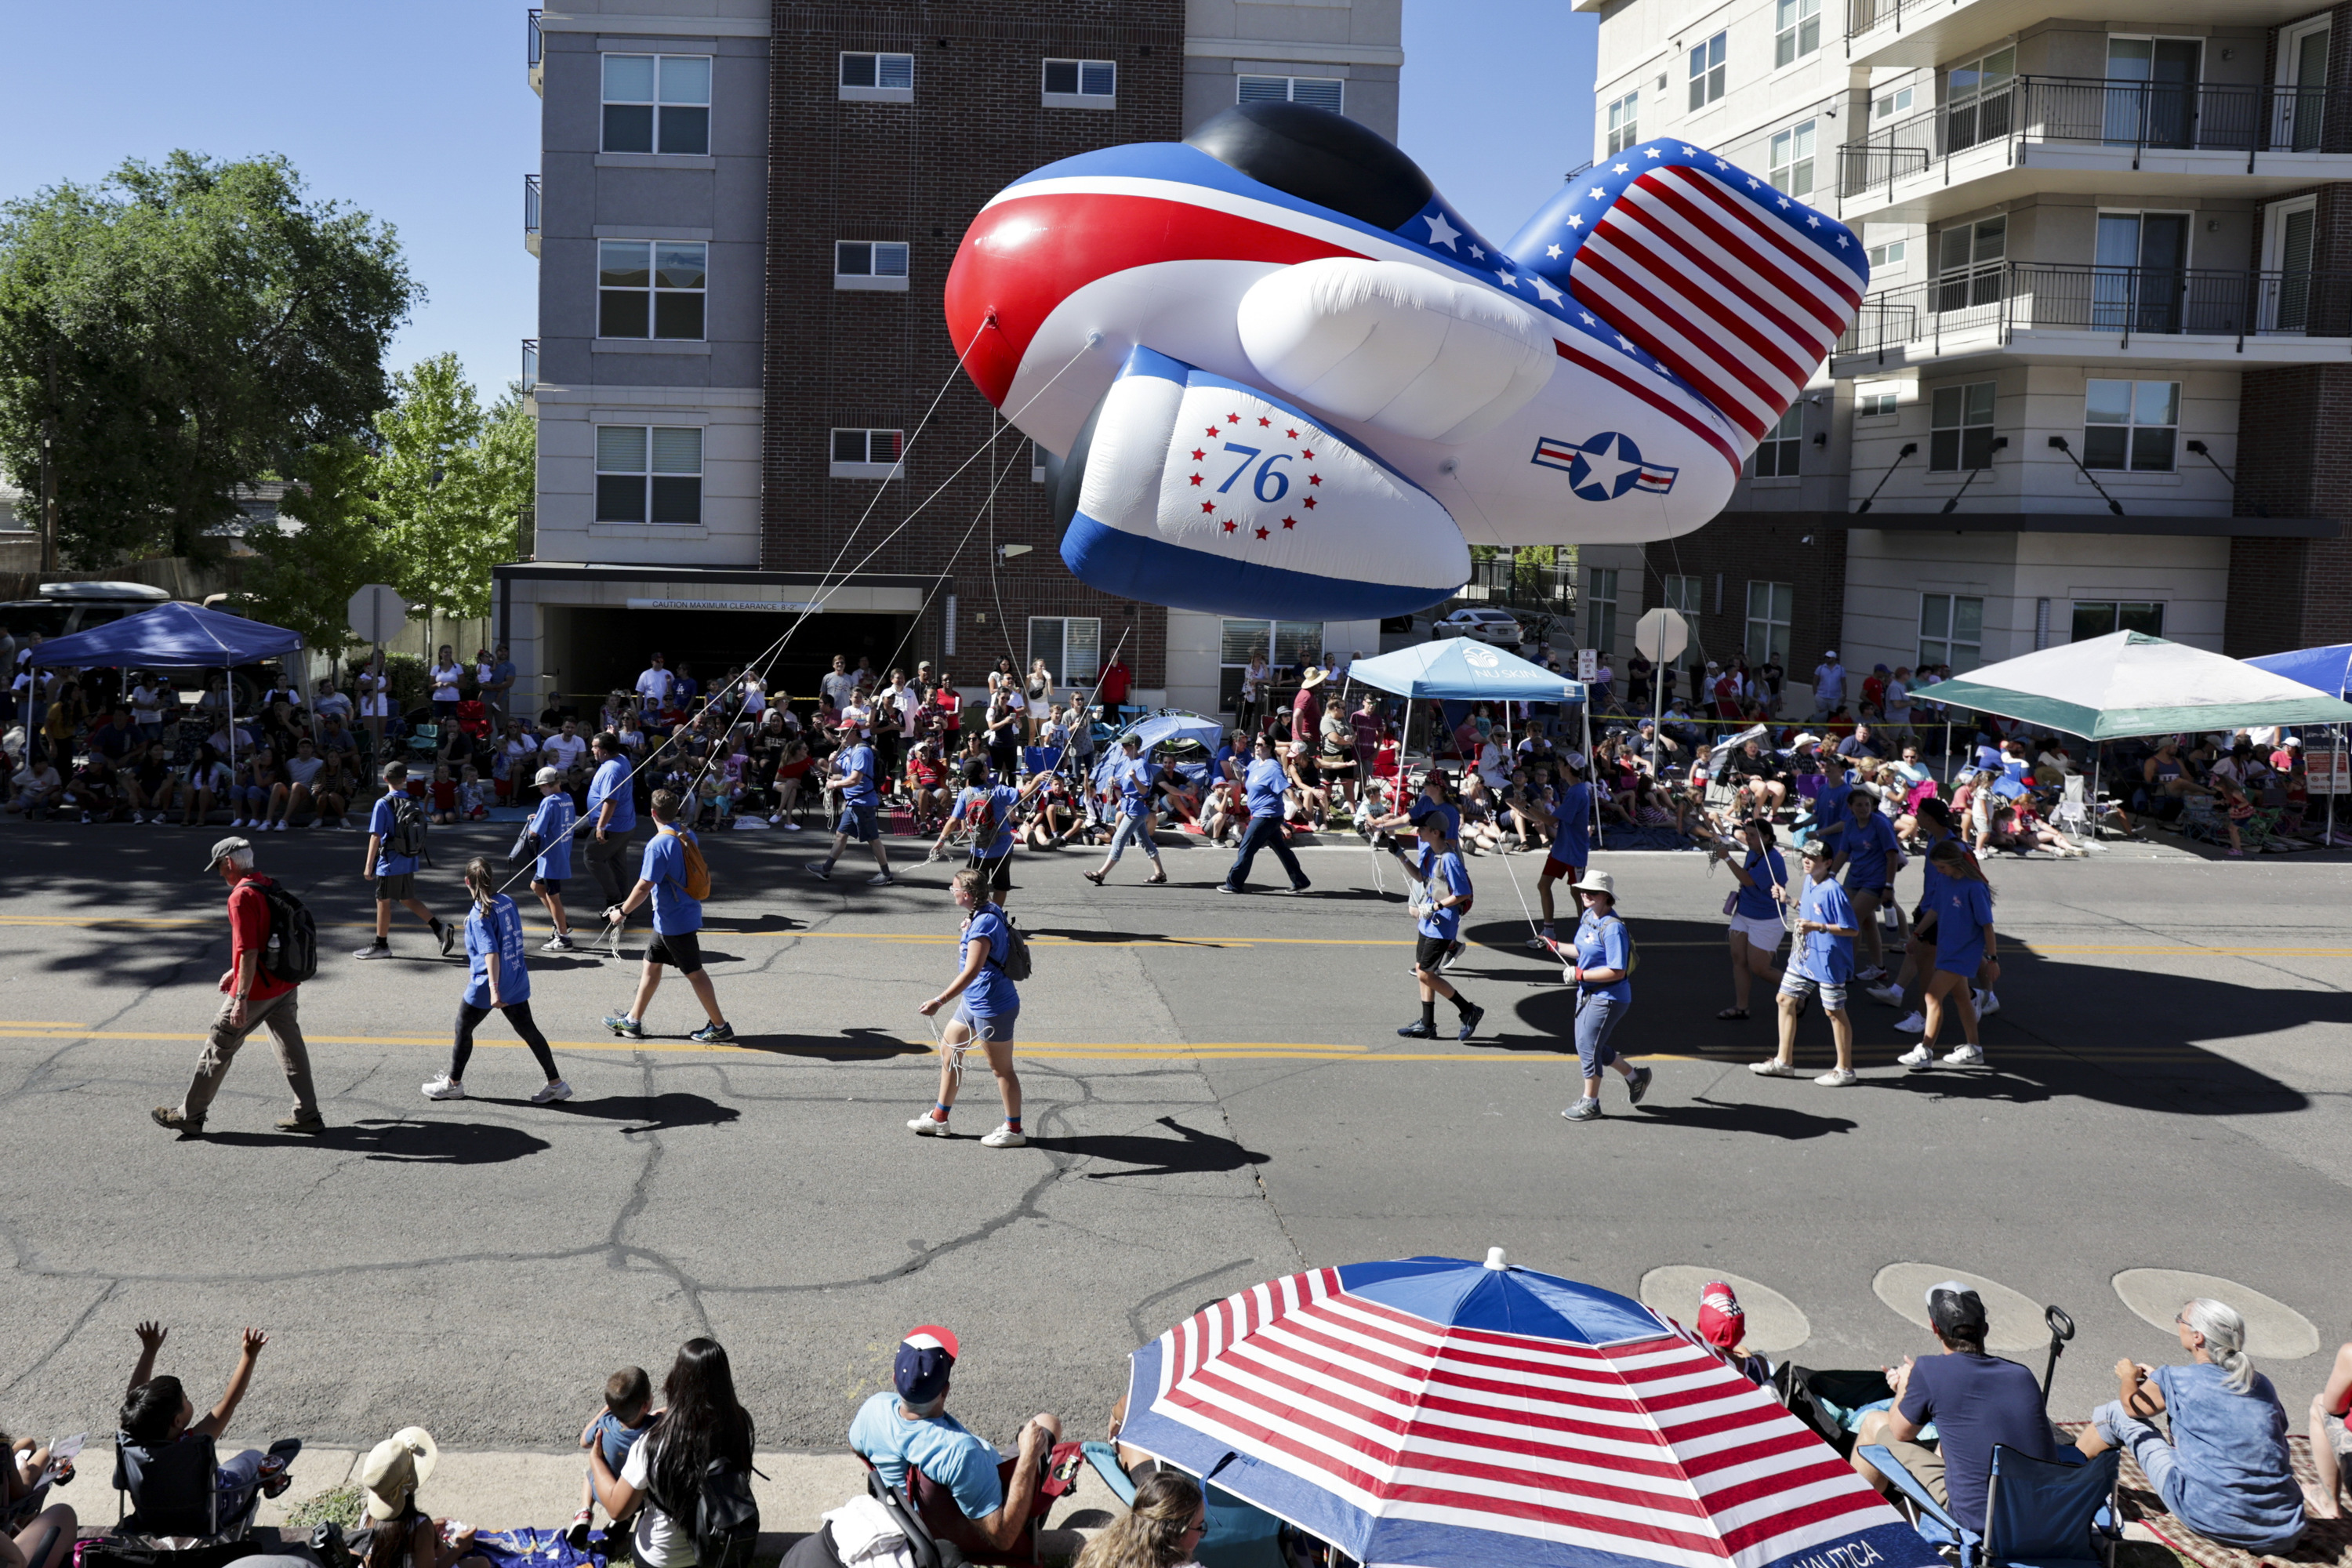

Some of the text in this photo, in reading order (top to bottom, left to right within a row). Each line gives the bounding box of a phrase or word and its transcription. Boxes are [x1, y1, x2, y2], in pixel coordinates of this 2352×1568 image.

[1216, 441, 1294, 503] 76
[652, 601, 688, 609] CAUTION
[690, 601, 728, 610] MAXIMUM
[729, 602, 779, 611] CLEARANCE:
[1475, 670, 1500, 678] NU
